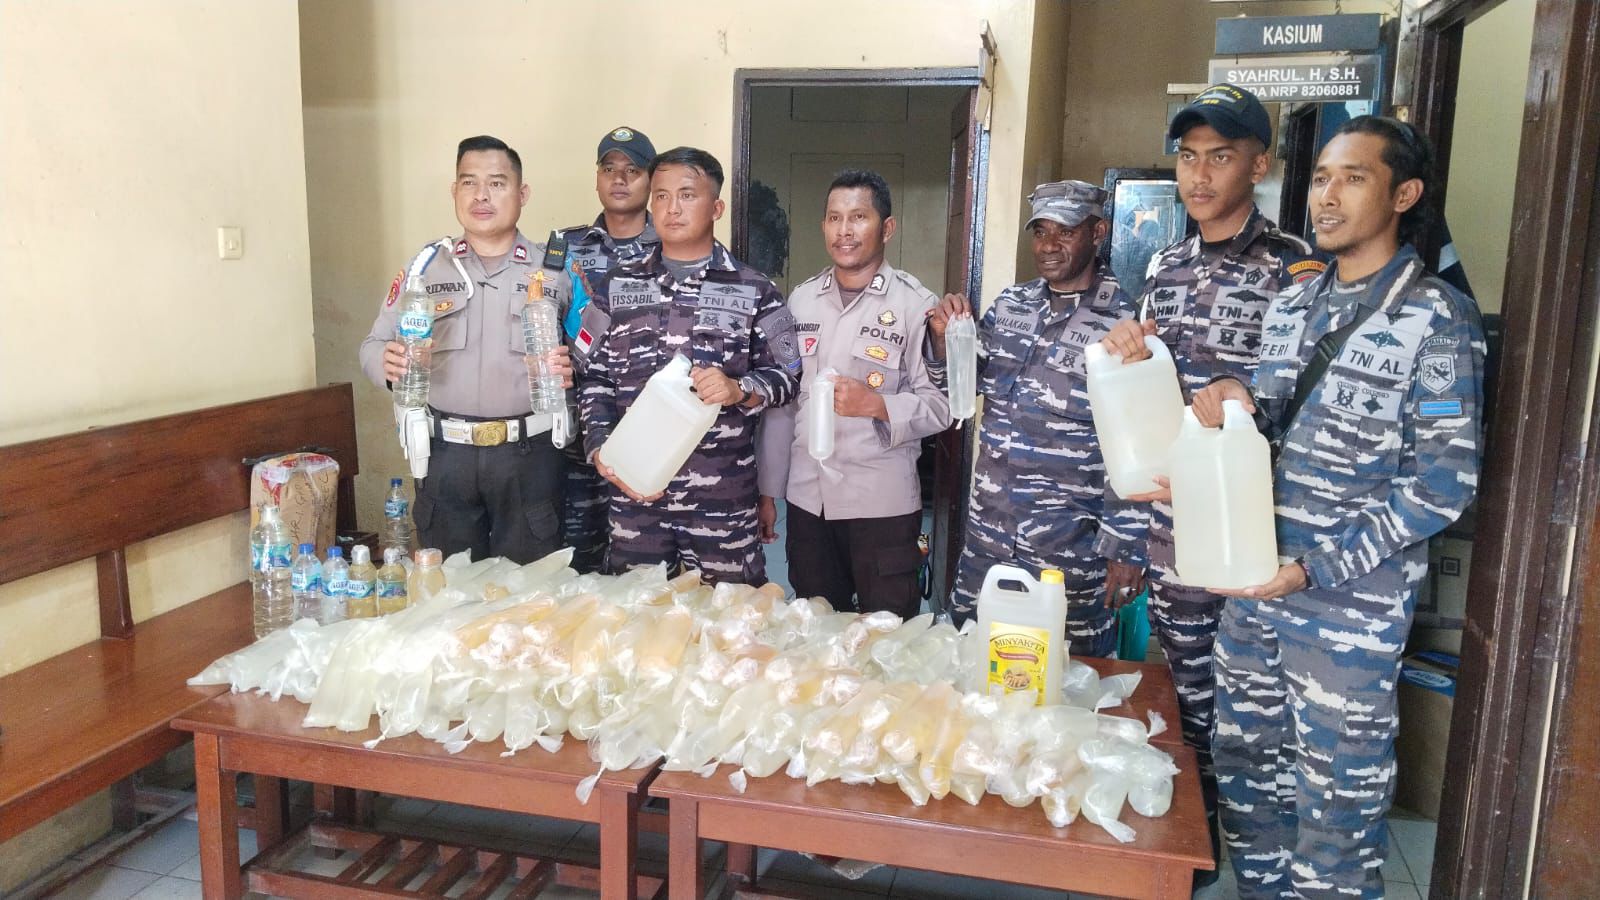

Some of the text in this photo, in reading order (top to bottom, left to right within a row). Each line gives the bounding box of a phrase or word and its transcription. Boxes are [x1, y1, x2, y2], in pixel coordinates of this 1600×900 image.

[1263, 24, 1322, 45] KASIUM
[1227, 67, 1360, 82] SYAHRUL. H, S.H.
[1270, 86, 1298, 97] NRP
[1301, 85, 1360, 96] 82060881
[425, 282, 467, 294] RIDWAN
[612, 294, 655, 307] FISSABIL
[704, 296, 749, 310] TNI AL
[403, 317, 428, 328] AQUA
[860, 326, 904, 345] POLRI
[1070, 330, 1090, 344] TNI
[1261, 343, 1289, 356] FERI
[1349, 349, 1405, 375] TNI AL
